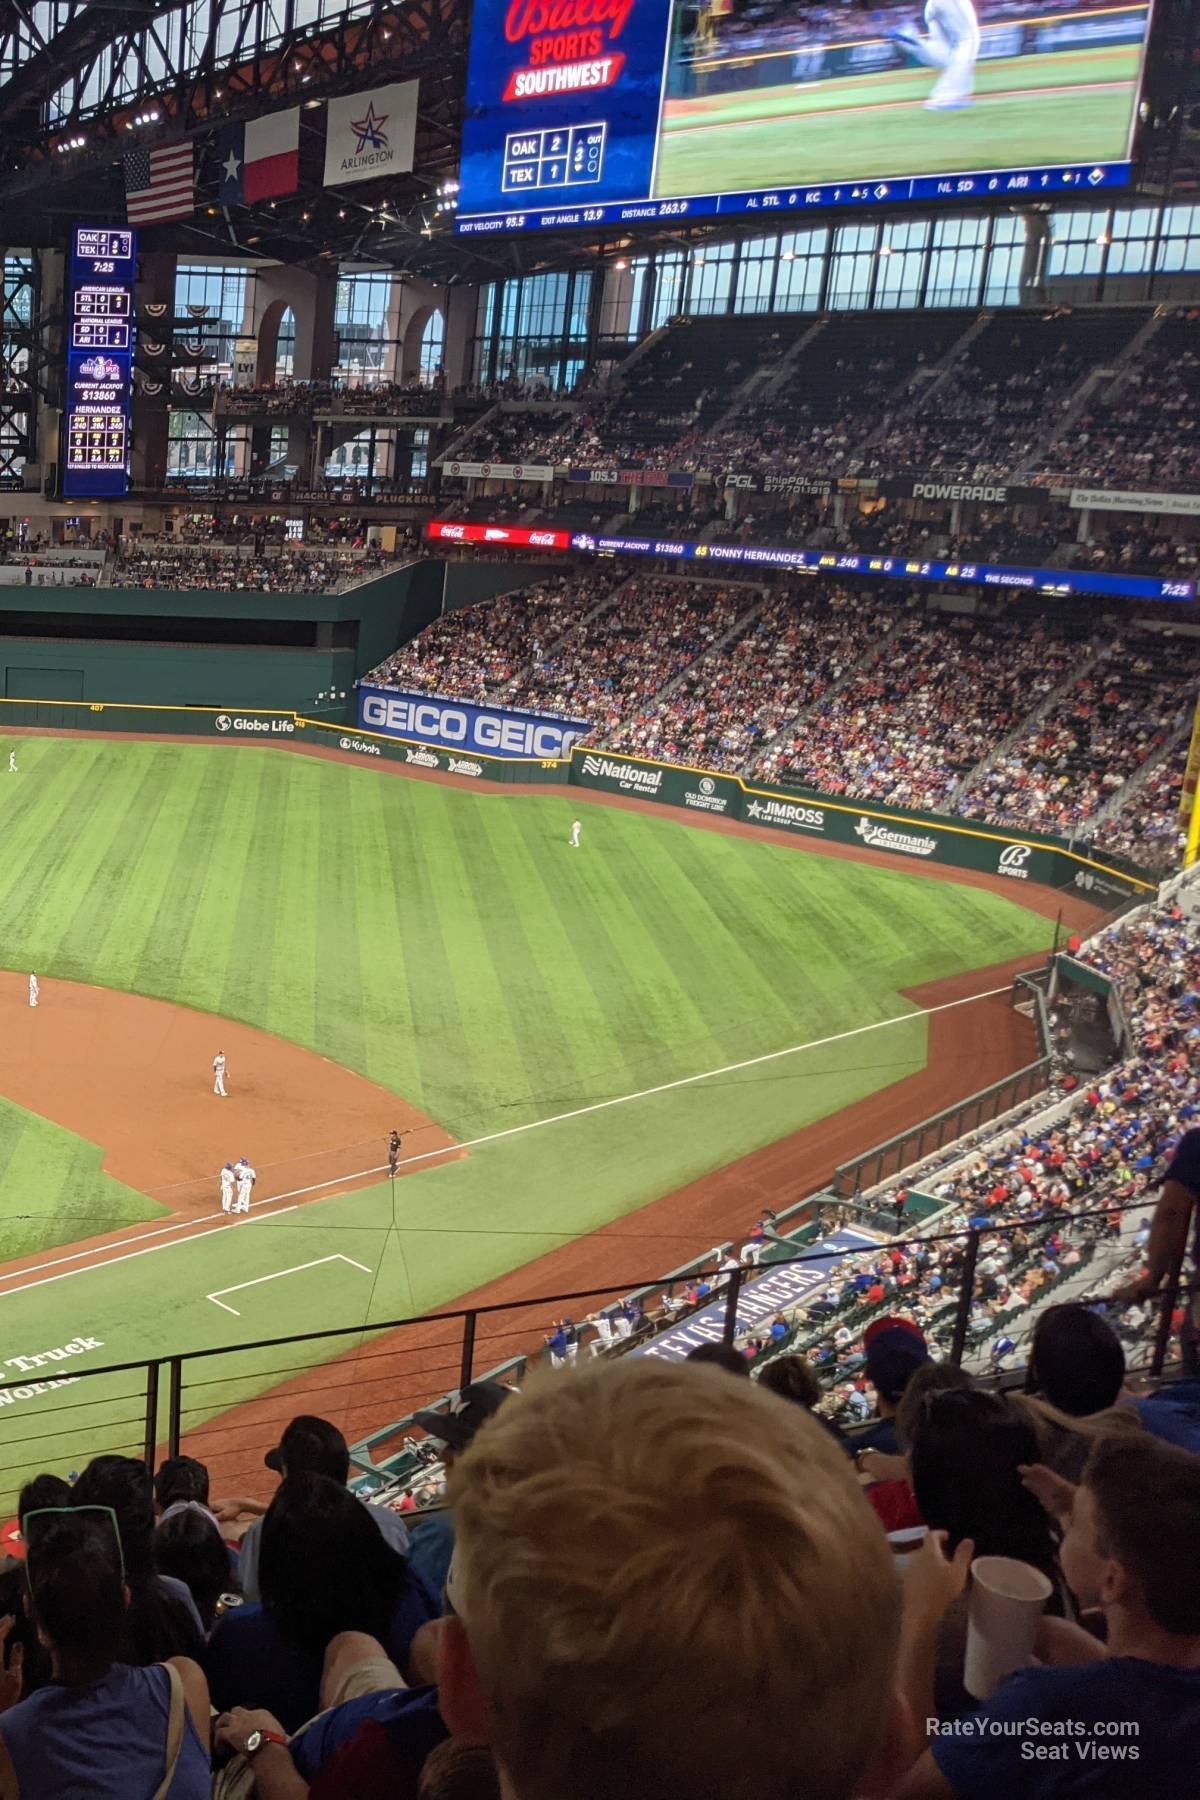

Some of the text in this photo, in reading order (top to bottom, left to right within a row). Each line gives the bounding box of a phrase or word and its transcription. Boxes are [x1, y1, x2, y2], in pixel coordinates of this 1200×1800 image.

[530, 29, 603, 65] SPORTS
[514, 60, 612, 97] SOUTHWEST
[511, 138, 560, 156] OAK 2
[341, 150, 394, 170] ARLINGTON
[575, 148, 584, 162] 3
[509, 166, 558, 182] TEX 1
[938, 176, 1029, 193] NL SD 0 ARI
[746, 192, 821, 208] AL STL 0 KC
[460, 202, 688, 232] EXIT VELOCITY 95.5 EXIT ANGLE 13.9 DISTANCE 263.9
[80, 233, 106, 243] OAK 2
[81, 246, 96, 254] TEX
[94, 262, 114, 272] 7:25
[82, 390, 116, 401] $13860
[75, 405, 121, 414] HERNANDEZ
[589, 471, 618, 482] 105.3
[725, 474, 757, 488] PGL
[912, 483, 1007, 501] POWERADE
[599, 540, 623, 549] CURRENT
[624, 542, 650, 551] JACKPOT
[695, 546, 707, 556] 65
[709, 547, 743, 560] YONNY
[743, 550, 804, 564] HERNANDEZ
[960, 568, 975, 577] 25
[985, 574, 1034, 585] THE SECOND
[1161, 583, 1189, 596] 7:25
[90, 704, 104, 712] 407
[233, 718, 295, 732] Globe Life
[363, 695, 468, 741] GEICO
[352, 740, 381, 755] Kubota
[541, 760, 557, 768] 374
[600, 761, 662, 785] National
[619, 780, 657, 794] Car Rental
[684, 791, 727, 806] OLD DOMINION
[685, 798, 725, 812] FREIGHT LINE
[761, 813, 791, 825] LAW GROUP
[877, 827, 937, 850] Germania
[998, 865, 1028, 879] SPORTS
[3, 1336, 104, 1373] Truck
